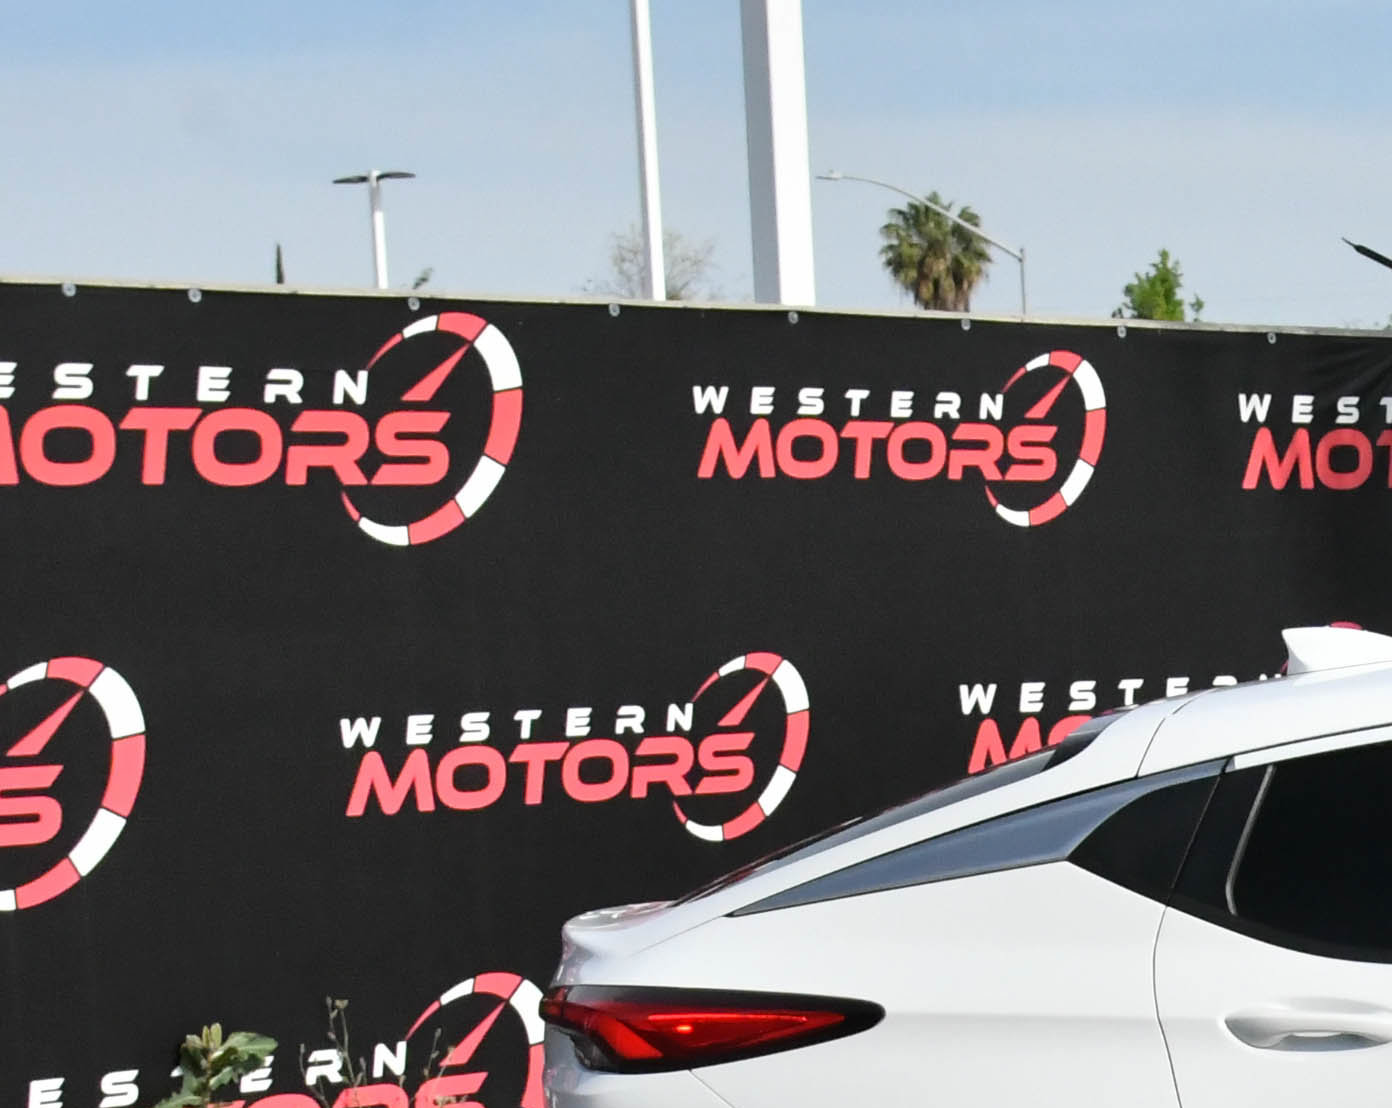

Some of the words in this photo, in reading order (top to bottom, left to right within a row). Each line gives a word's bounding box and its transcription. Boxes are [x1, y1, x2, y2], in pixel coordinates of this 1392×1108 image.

[692, 385, 1004, 420] WESTERN
[0, 404, 451, 487] OTORS
[697, 417, 1059, 482] MOTORS
[959, 673, 1282, 716] WESTE
[339, 702, 694, 749] WESTERN
[345, 732, 756, 817] MOTORS
